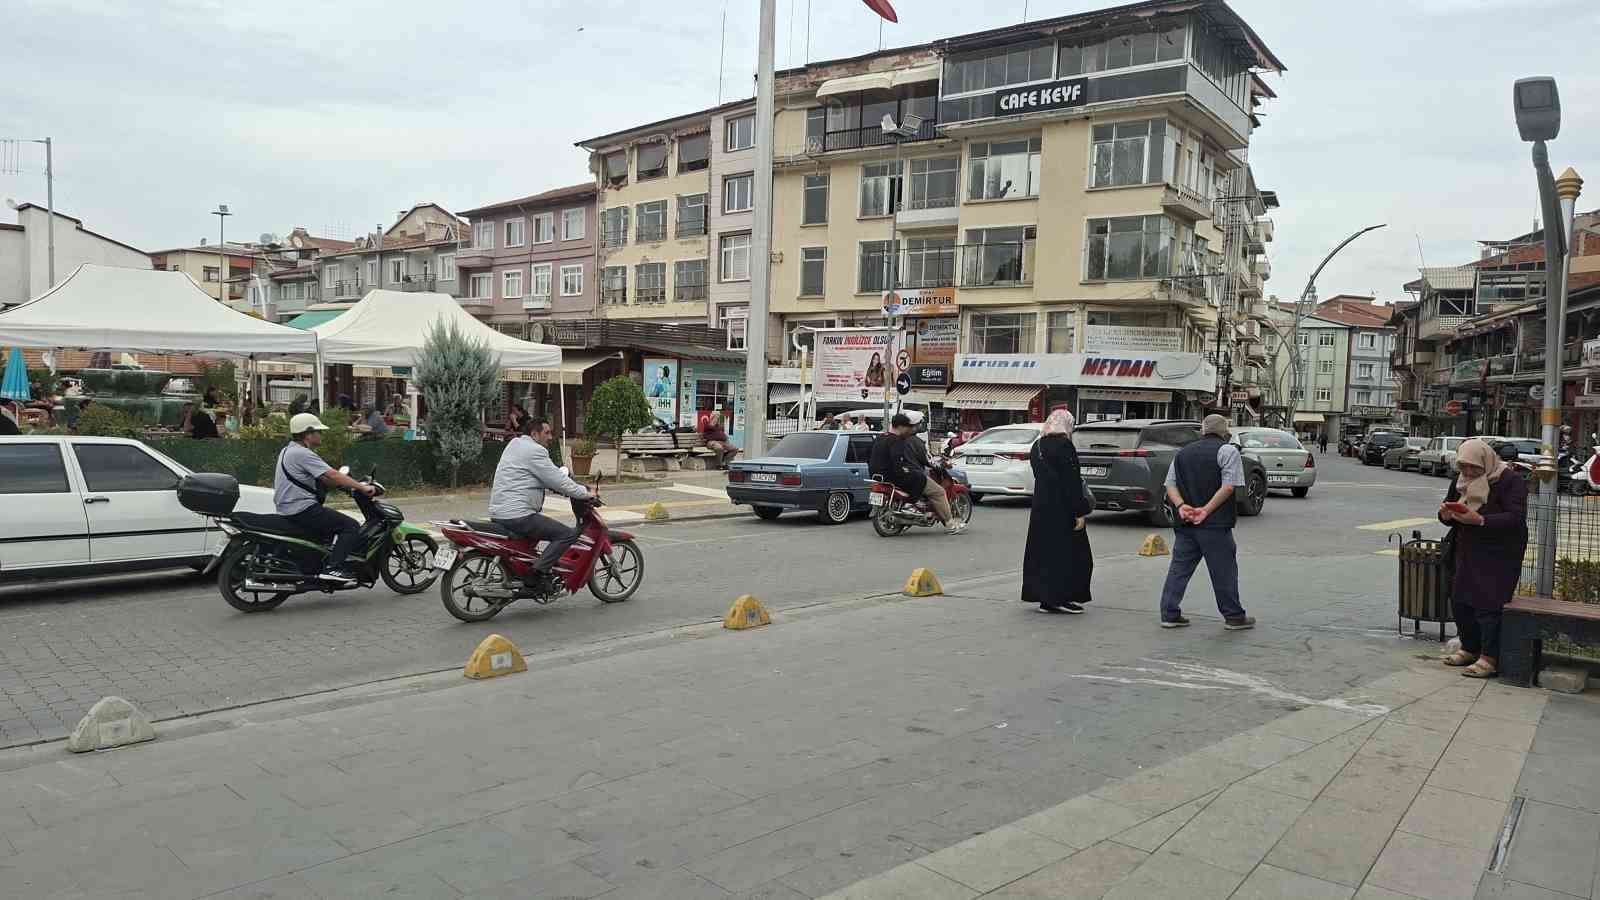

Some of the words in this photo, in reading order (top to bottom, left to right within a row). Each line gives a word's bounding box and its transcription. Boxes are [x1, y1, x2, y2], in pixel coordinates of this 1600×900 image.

[999, 90, 1038, 110] CAFE
[1040, 84, 1081, 105] KEYF
[902, 295, 952, 306] DEMİRTUR
[1081, 357, 1158, 378] MEYDAN
